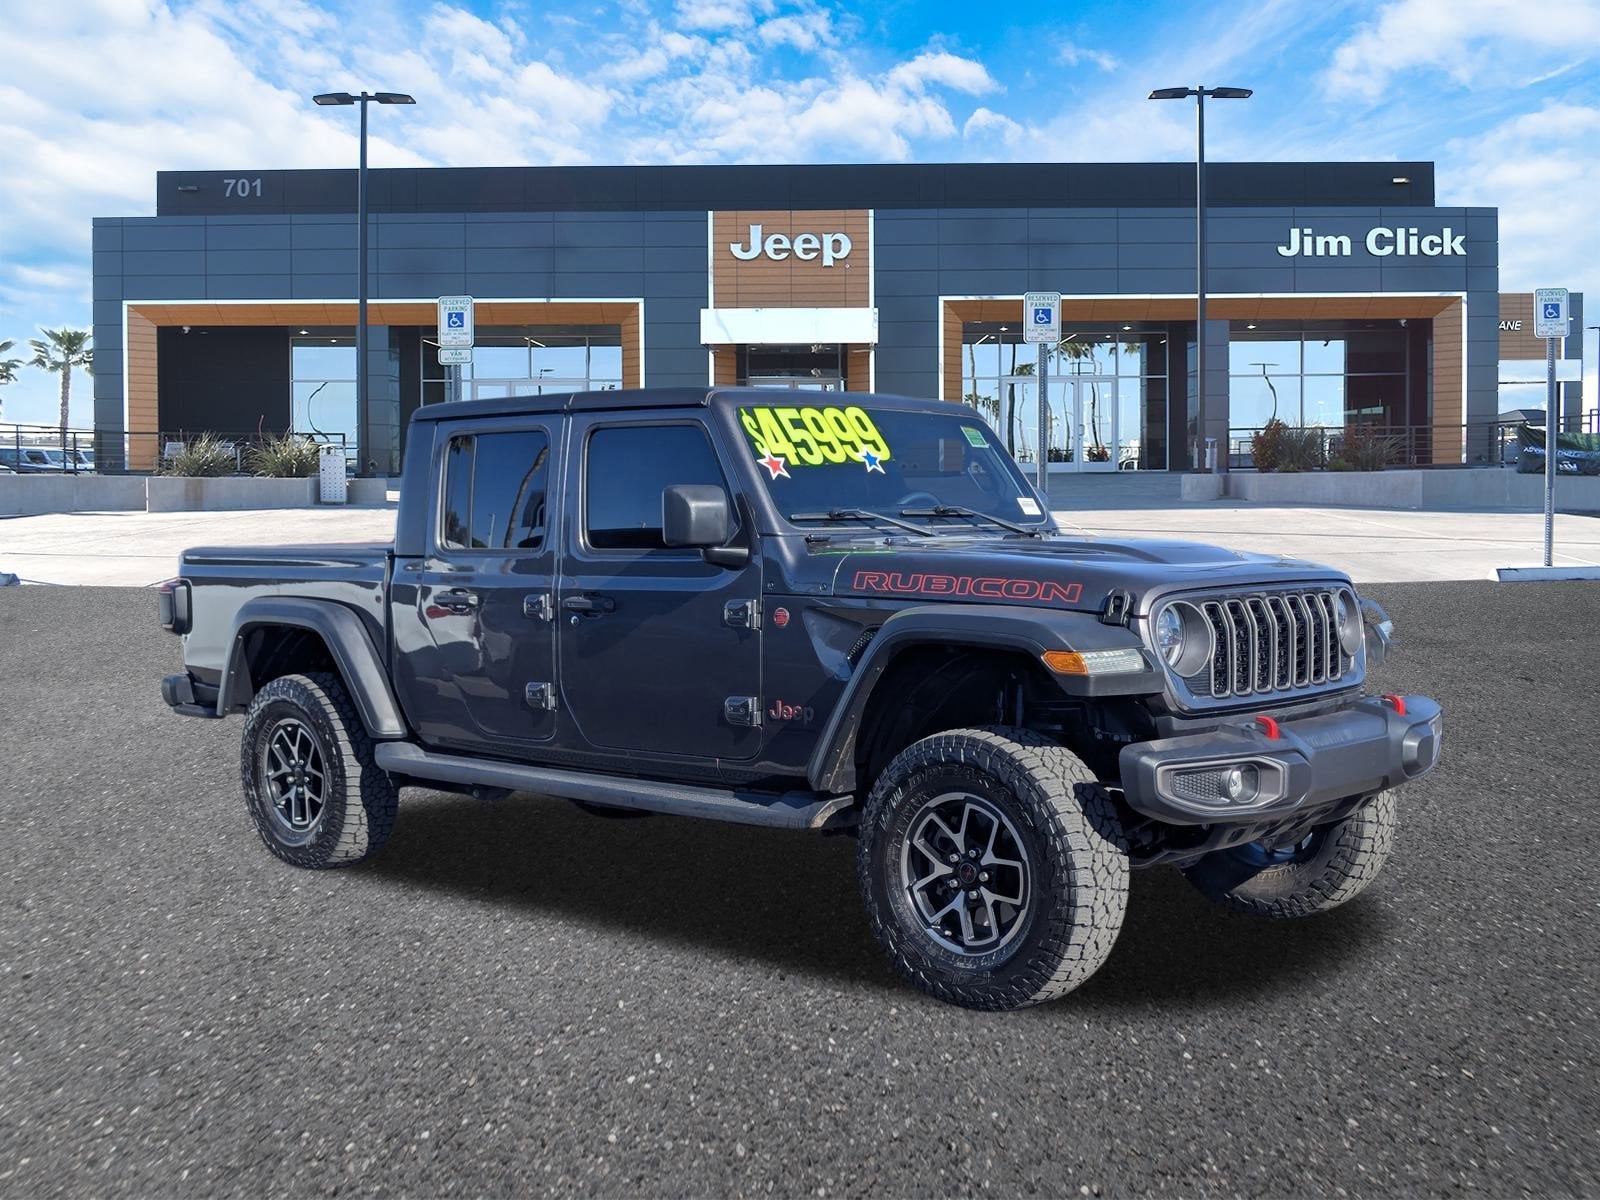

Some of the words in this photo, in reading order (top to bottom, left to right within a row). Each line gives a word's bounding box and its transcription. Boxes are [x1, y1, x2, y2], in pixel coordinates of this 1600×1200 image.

[223, 178, 262, 197] 701
[730, 224, 852, 267] Jeep
[1277, 227, 1352, 257] Jim
[1365, 227, 1467, 256] Click
[738, 406, 892, 466] $45999
[853, 571, 1083, 604] RUBICON
[769, 699, 815, 724] Jeep
